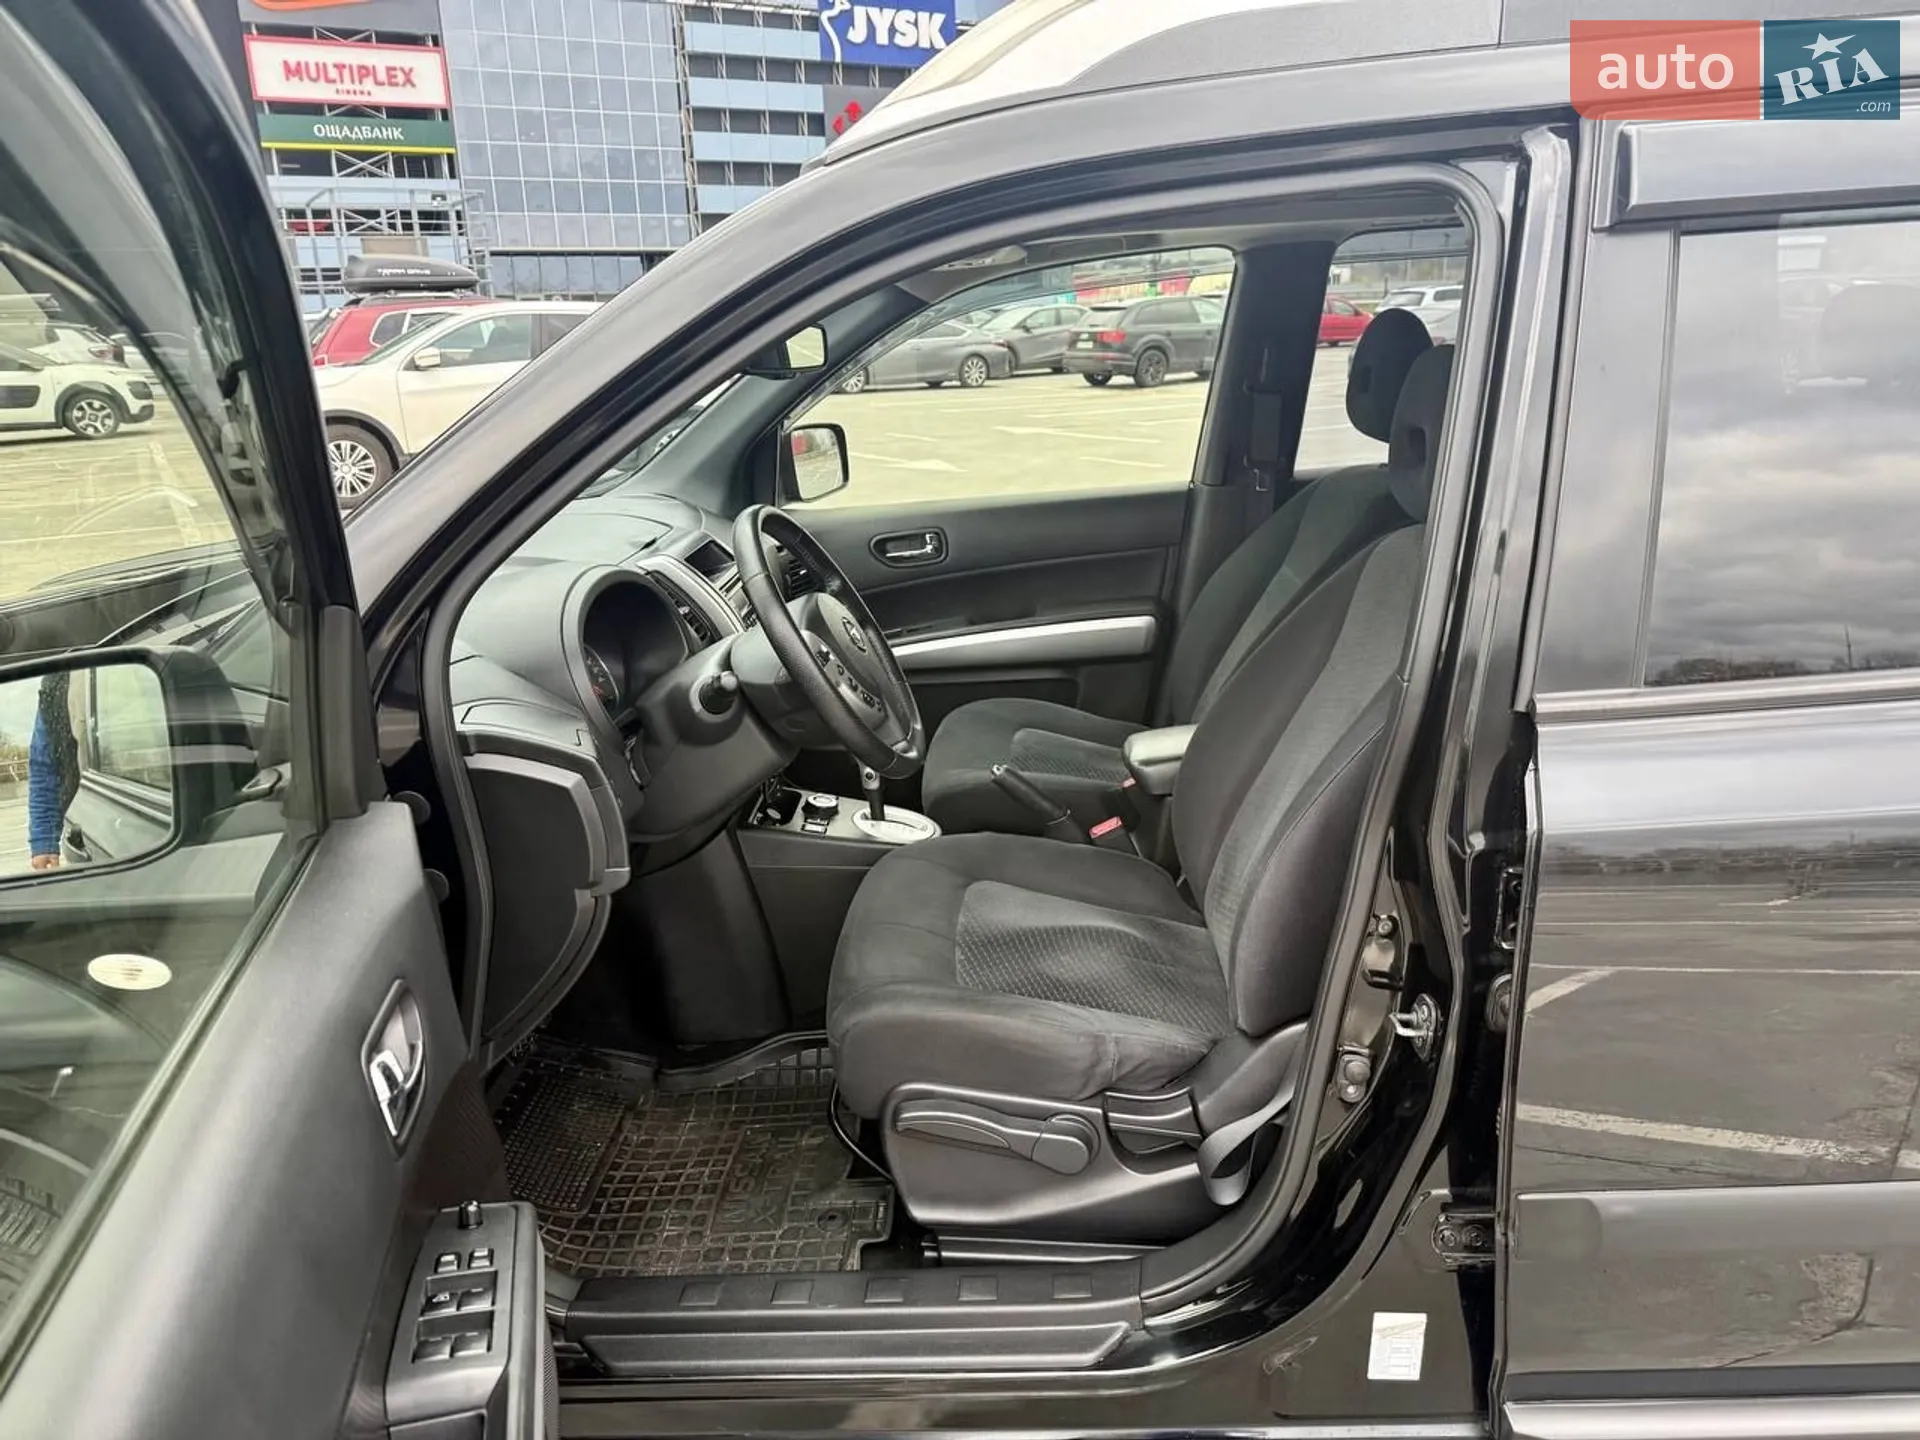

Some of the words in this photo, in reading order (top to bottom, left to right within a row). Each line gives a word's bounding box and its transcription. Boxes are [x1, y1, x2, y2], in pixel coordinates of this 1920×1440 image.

[847, 5, 948, 49] JYSK
[282, 59, 417, 88] MULTIPLEX
[313, 123, 405, 141] ОЩАДБАНК
